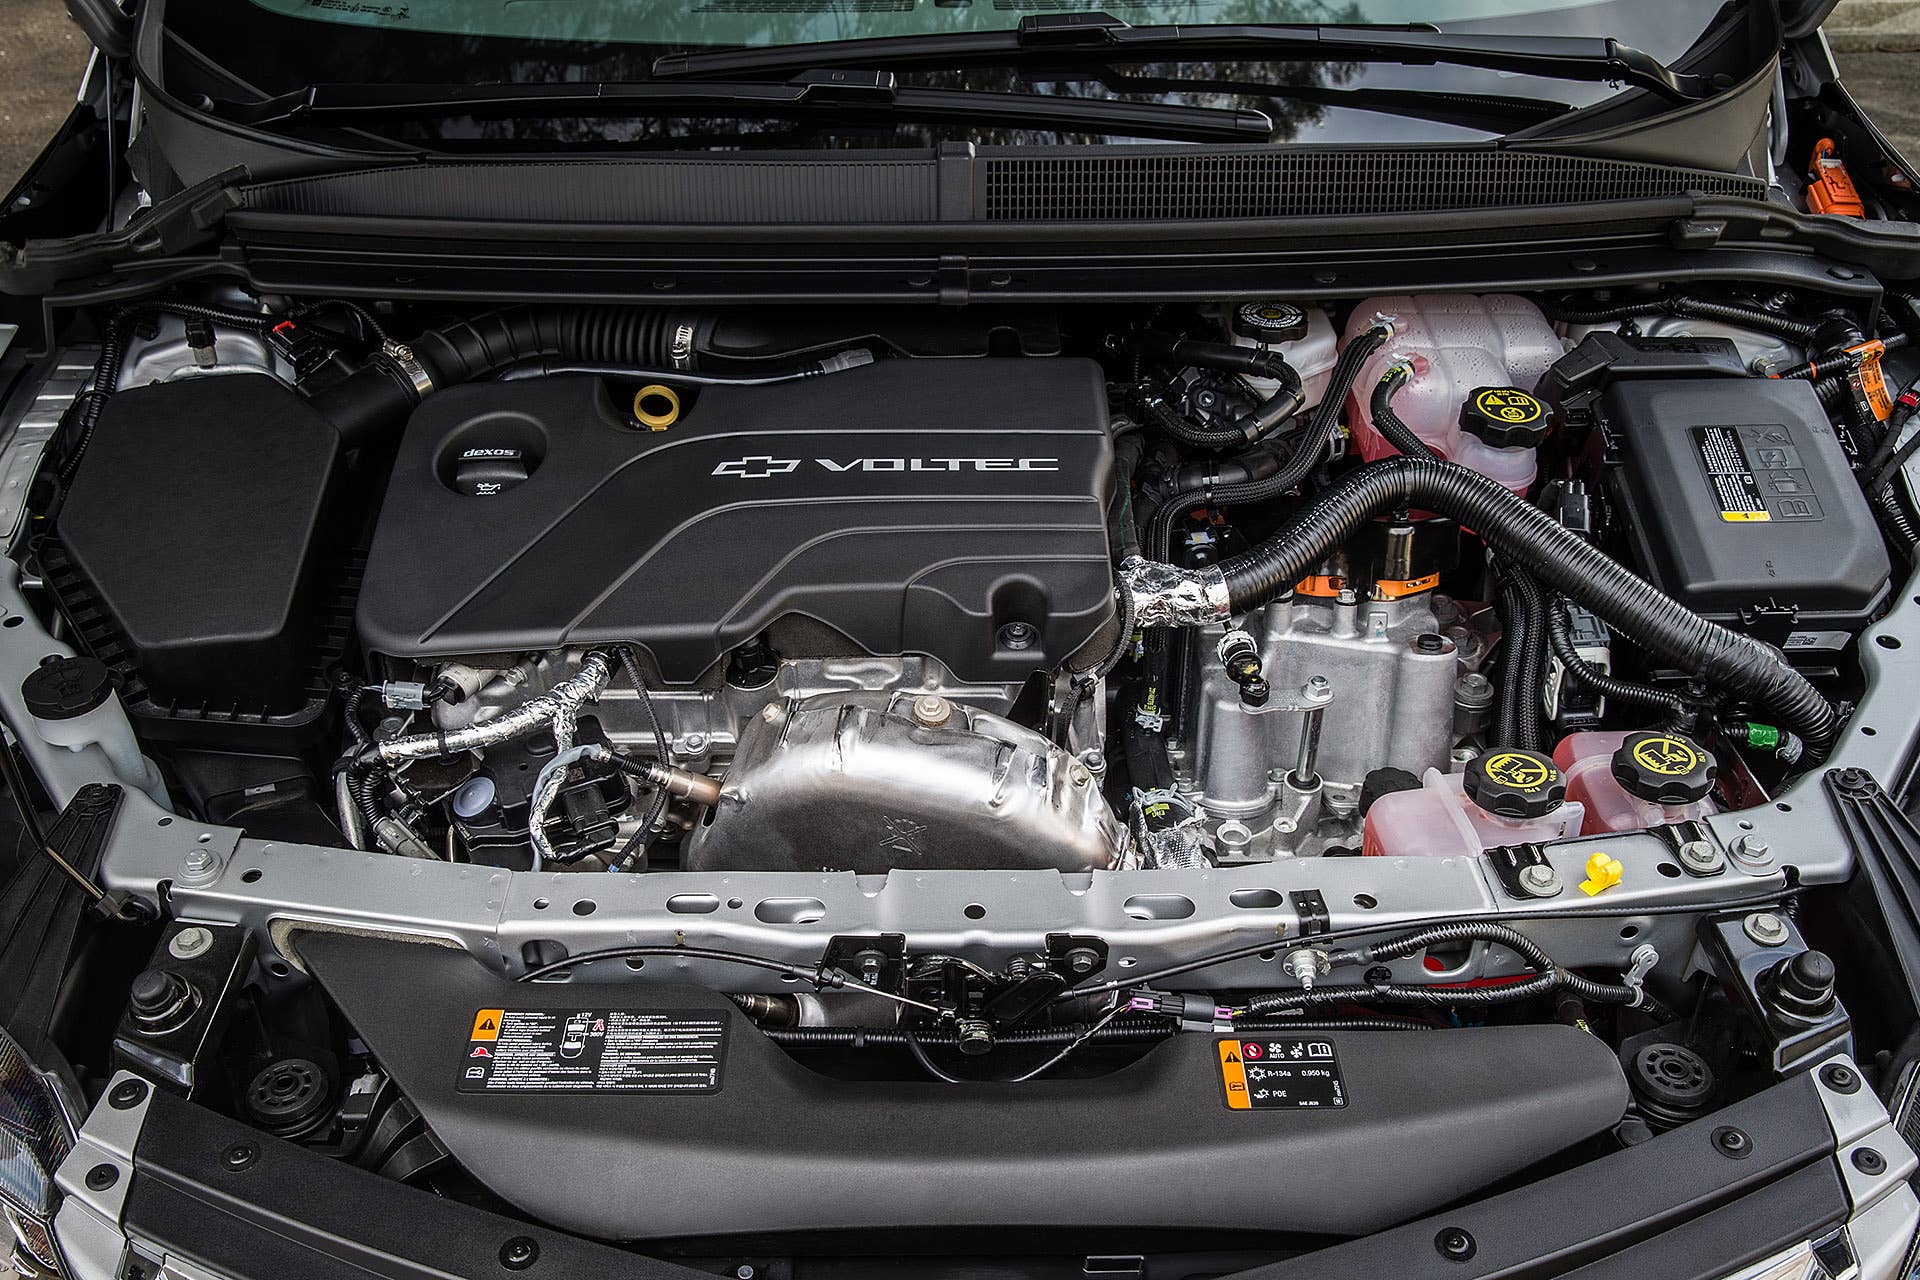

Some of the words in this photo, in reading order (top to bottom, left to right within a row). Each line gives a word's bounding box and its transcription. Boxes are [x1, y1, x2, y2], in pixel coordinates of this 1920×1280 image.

[463, 449, 517, 457] dexos
[815, 458, 1059, 471] VOLTEC
[1301, 1069, 1321, 1077] 0.950
[1320, 1069, 1331, 1078] kg
